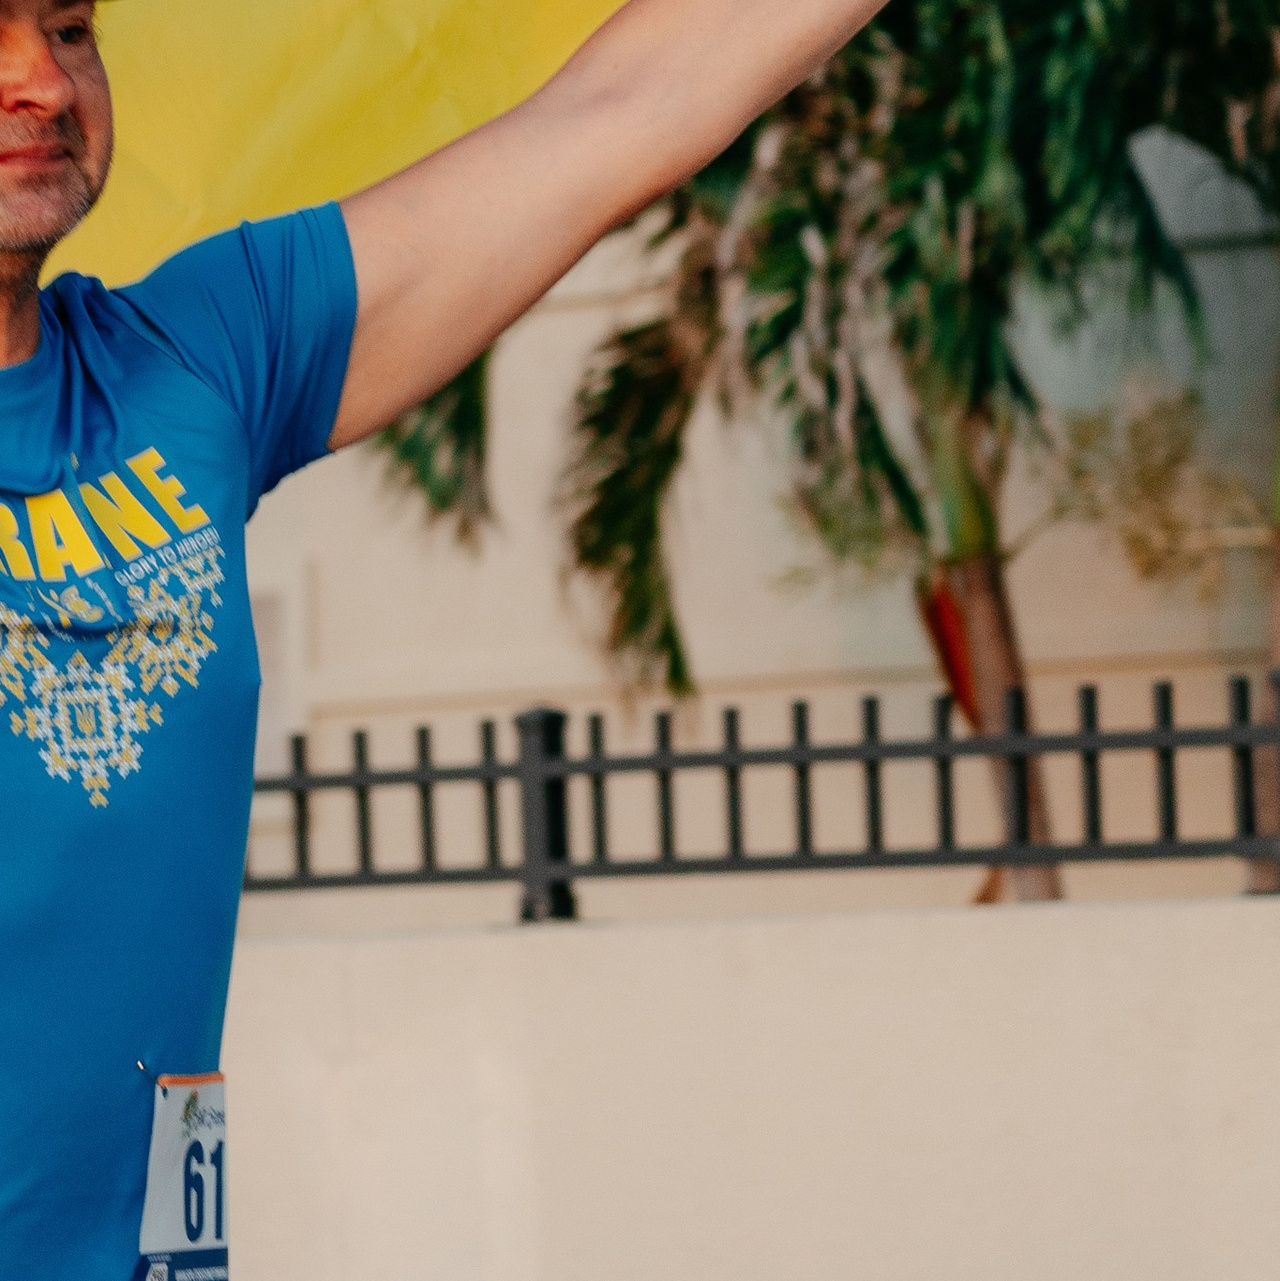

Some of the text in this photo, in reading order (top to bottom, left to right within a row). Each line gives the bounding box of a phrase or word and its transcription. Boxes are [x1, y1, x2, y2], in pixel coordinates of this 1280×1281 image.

[114, 553, 159, 587] GLORY
[156, 546, 177, 566] TO
[183, 1138, 223, 1243] 61
